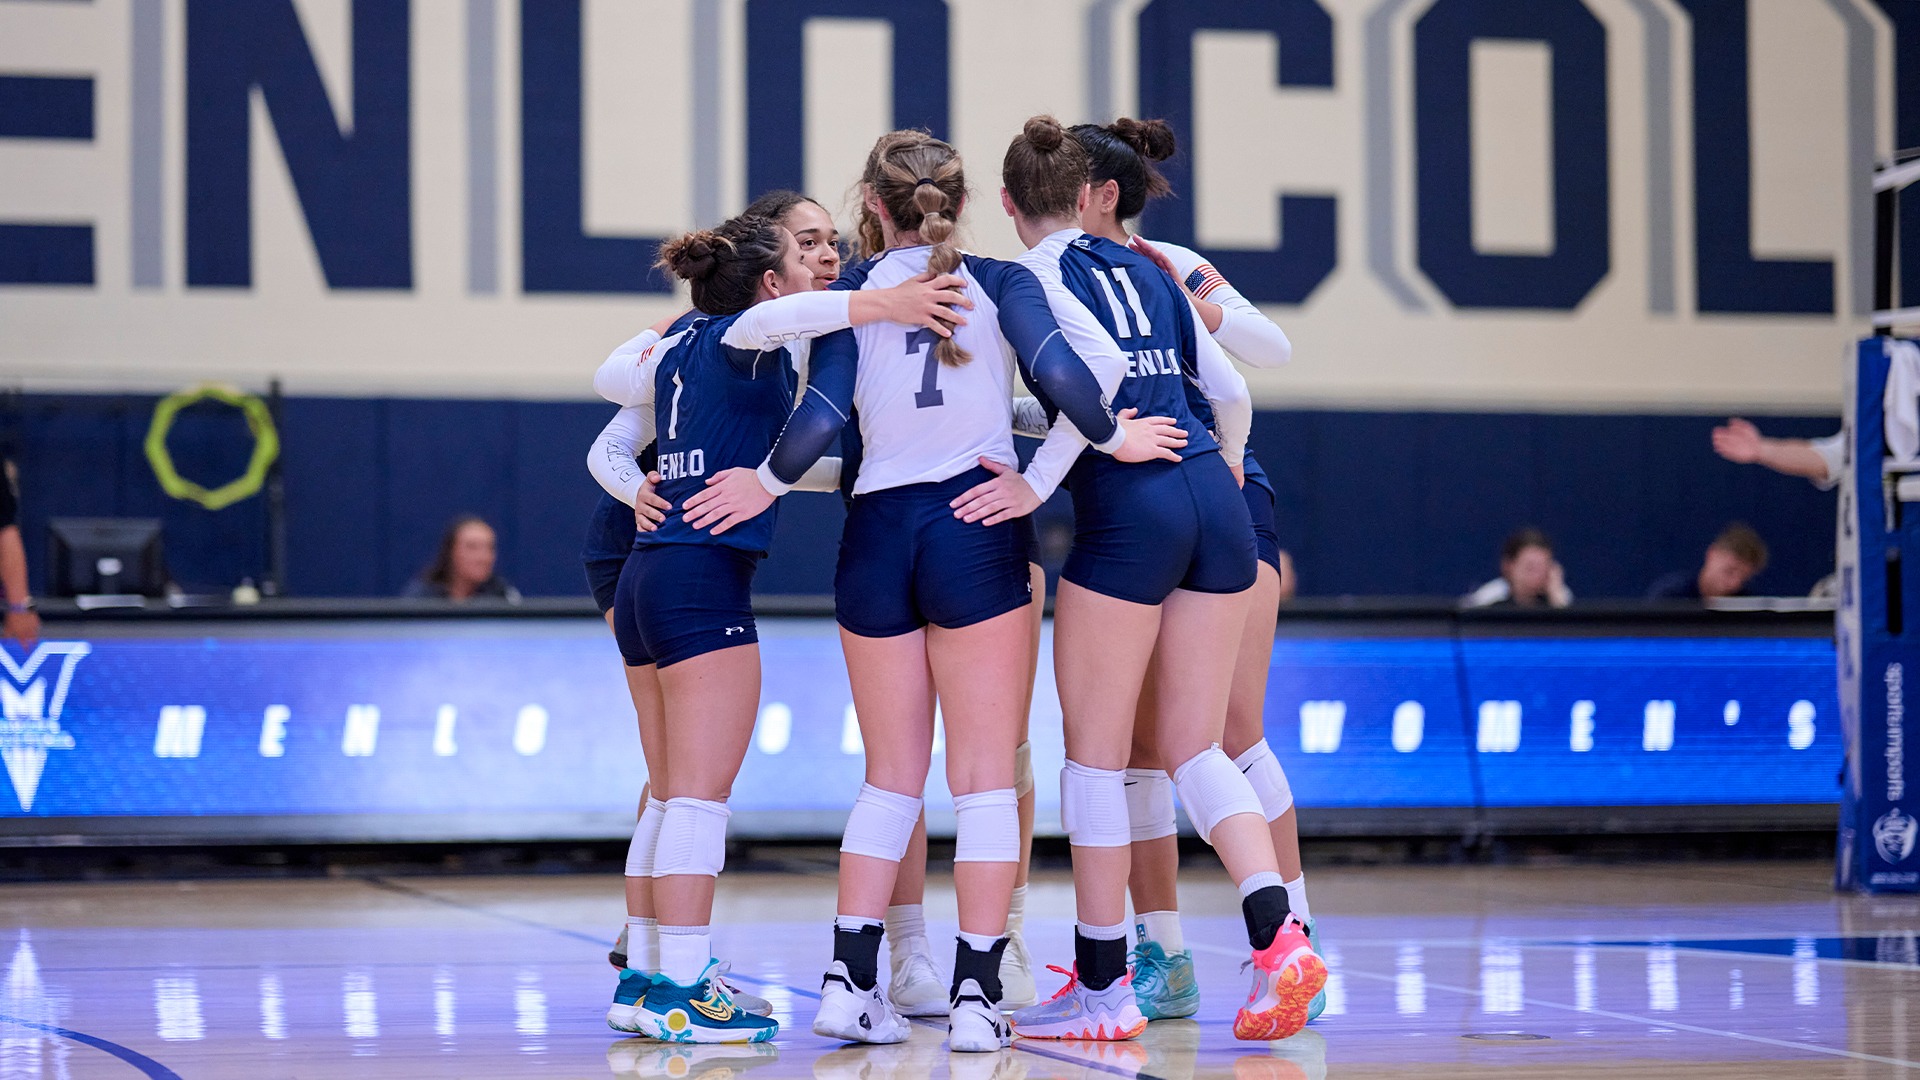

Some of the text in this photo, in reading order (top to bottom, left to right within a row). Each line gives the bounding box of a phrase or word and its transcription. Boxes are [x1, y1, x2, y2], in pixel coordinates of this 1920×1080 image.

[1137, 0, 1920, 315] COL
[1091, 267, 1152, 339] 11
[905, 328, 944, 409] 7
[1121, 348, 1182, 378] ENLO
[667, 367, 684, 440] 1
[657, 448, 705, 481] ENLO
[154, 700, 1817, 758] MENLO WOMEN'S
